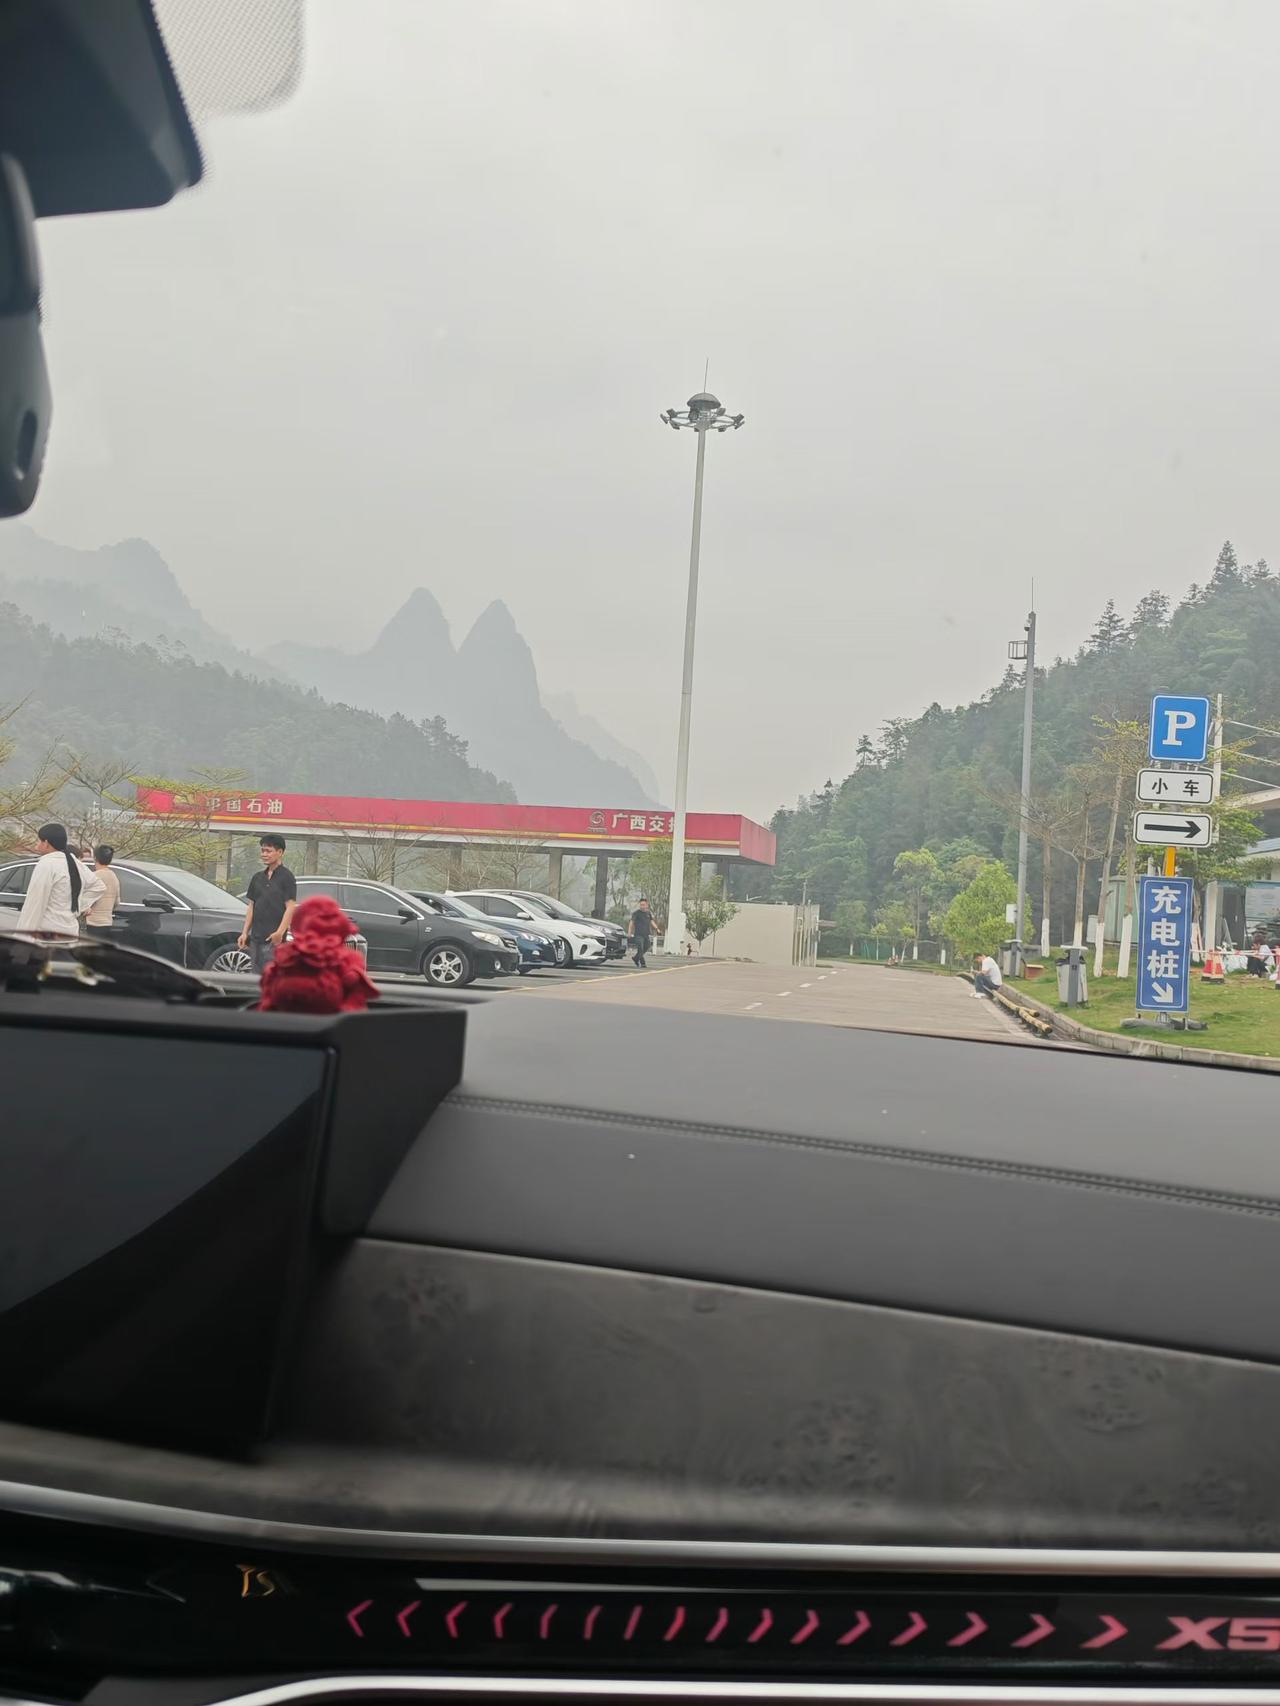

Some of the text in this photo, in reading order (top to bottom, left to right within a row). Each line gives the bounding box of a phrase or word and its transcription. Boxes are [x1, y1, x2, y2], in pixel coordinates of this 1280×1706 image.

[1162, 710, 1196, 746] P
[1151, 777, 1200, 797] 小车
[1146, 885, 1182, 979] 充电桩
